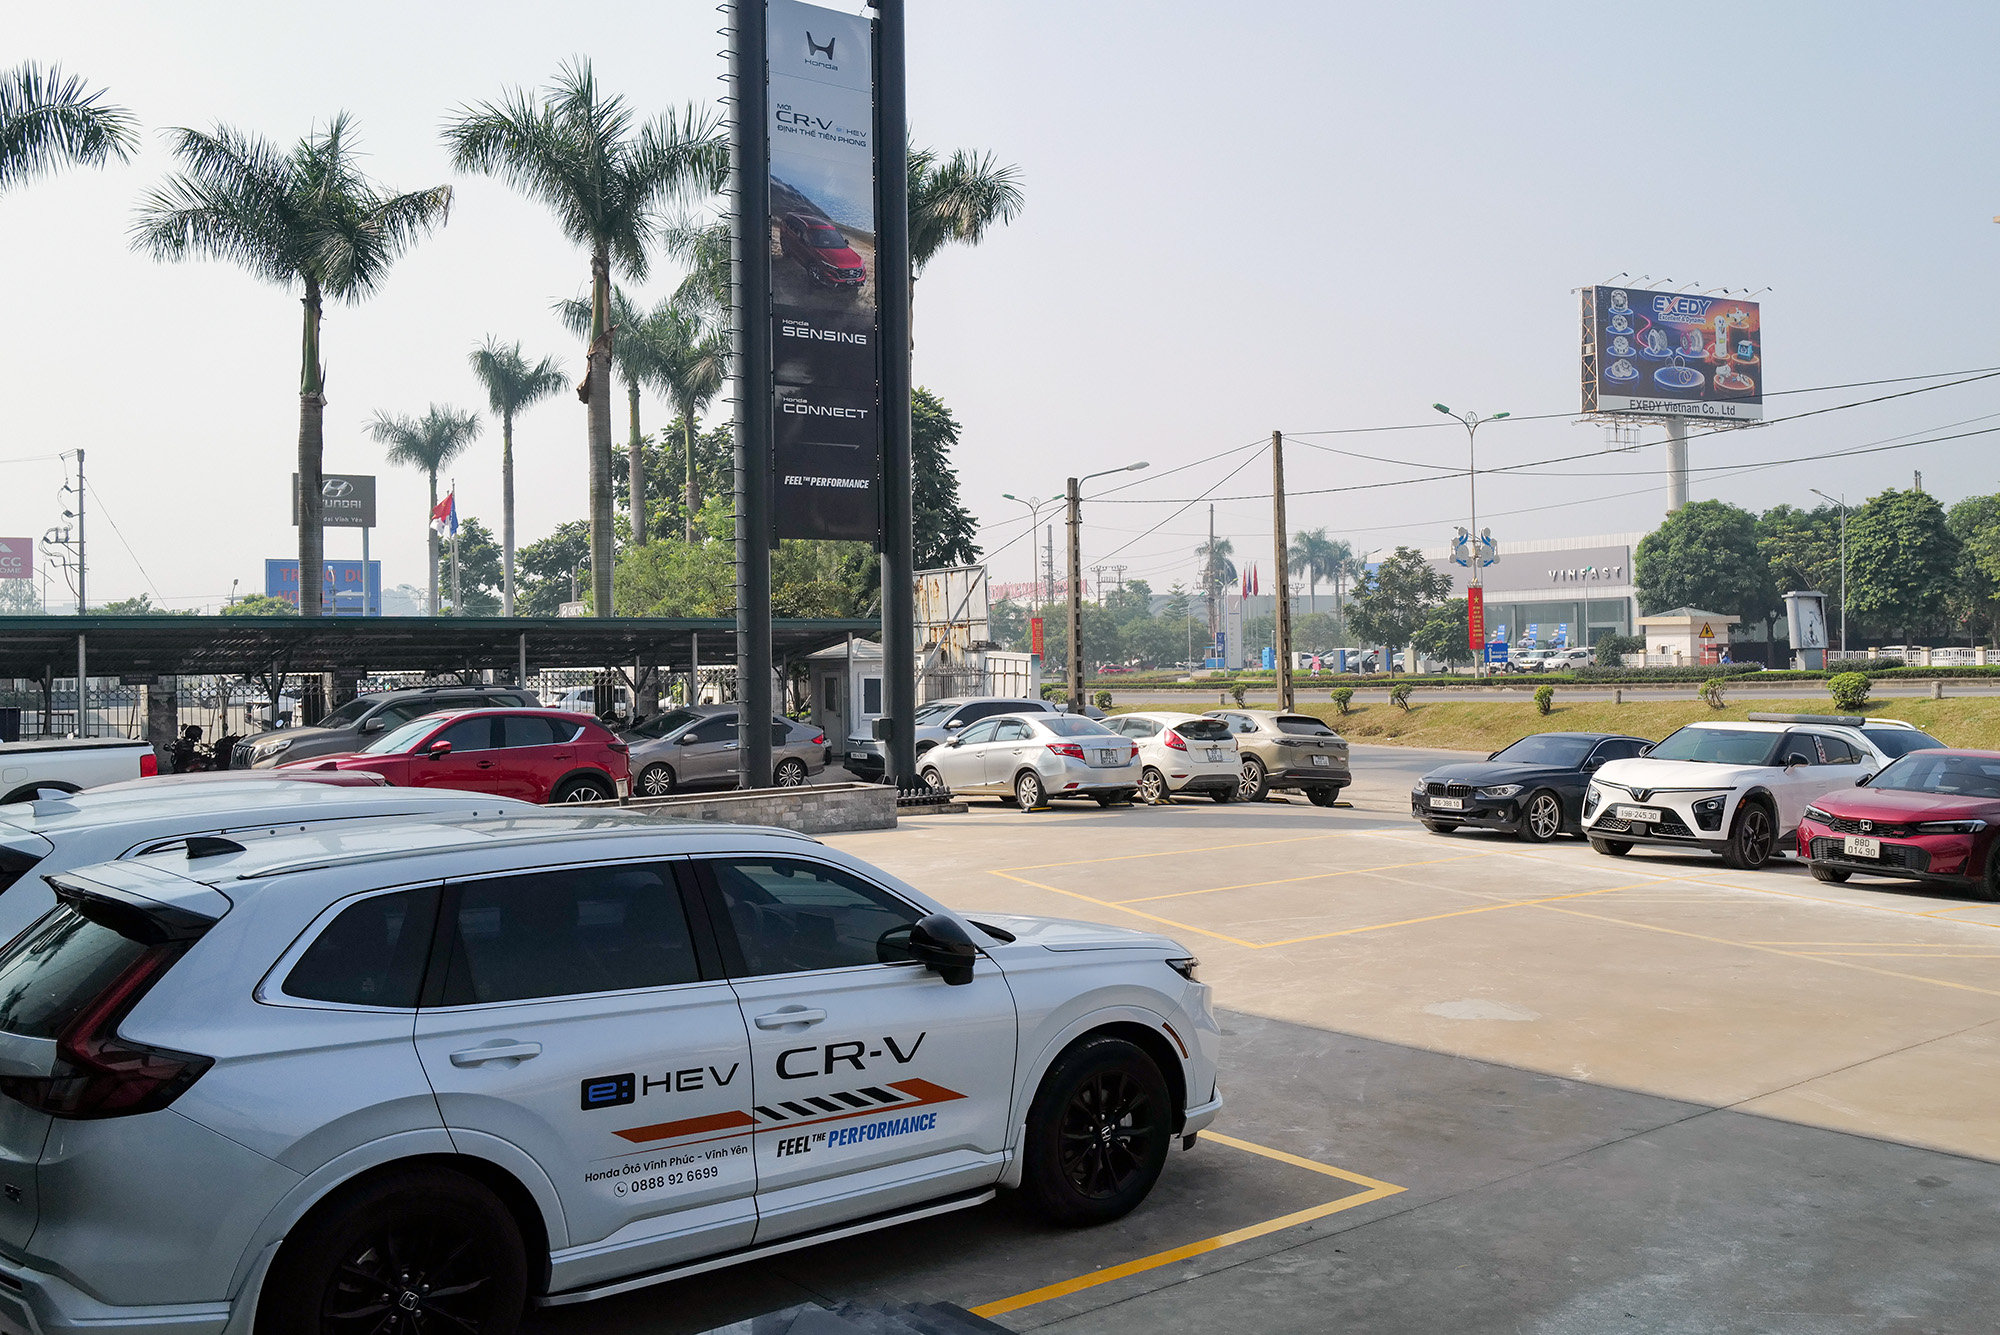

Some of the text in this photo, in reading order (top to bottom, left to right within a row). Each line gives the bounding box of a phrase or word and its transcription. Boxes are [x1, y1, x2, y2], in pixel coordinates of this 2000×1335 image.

[804, 58, 838, 71] Honda
[776, 110, 832, 130] CR-V
[838, 136, 867, 147] PHONG
[1653, 296, 1711, 316] EXEDY
[782, 318, 810, 326] Honda
[782, 326, 867, 345] SENSING
[783, 403, 868, 419] CONNECT
[1629, 399, 1736, 415] EXEDY Vietnam Co., Ltd
[784, 475, 803, 486] FEEL
[810, 476, 870, 489] PERFORMANCE
[323, 499, 362, 509] UNDAI
[1548, 566, 1621, 582] VINFAST
[776, 1032, 926, 1080] CR-V
[777, 1112, 938, 1158] FEEL THE PERFORMANCE
[584, 1168, 620, 1183] Honda
[622, 1163, 641, 1176] Ôtô
[643, 1159, 668, 1171] Vĩnh
[669, 1153, 695, 1167] Phúc
[705, 1148, 728, 1160] Vĩnh
[730, 1144, 748, 1156] Yên
[631, 1165, 719, 1193] 0888 92 6699
